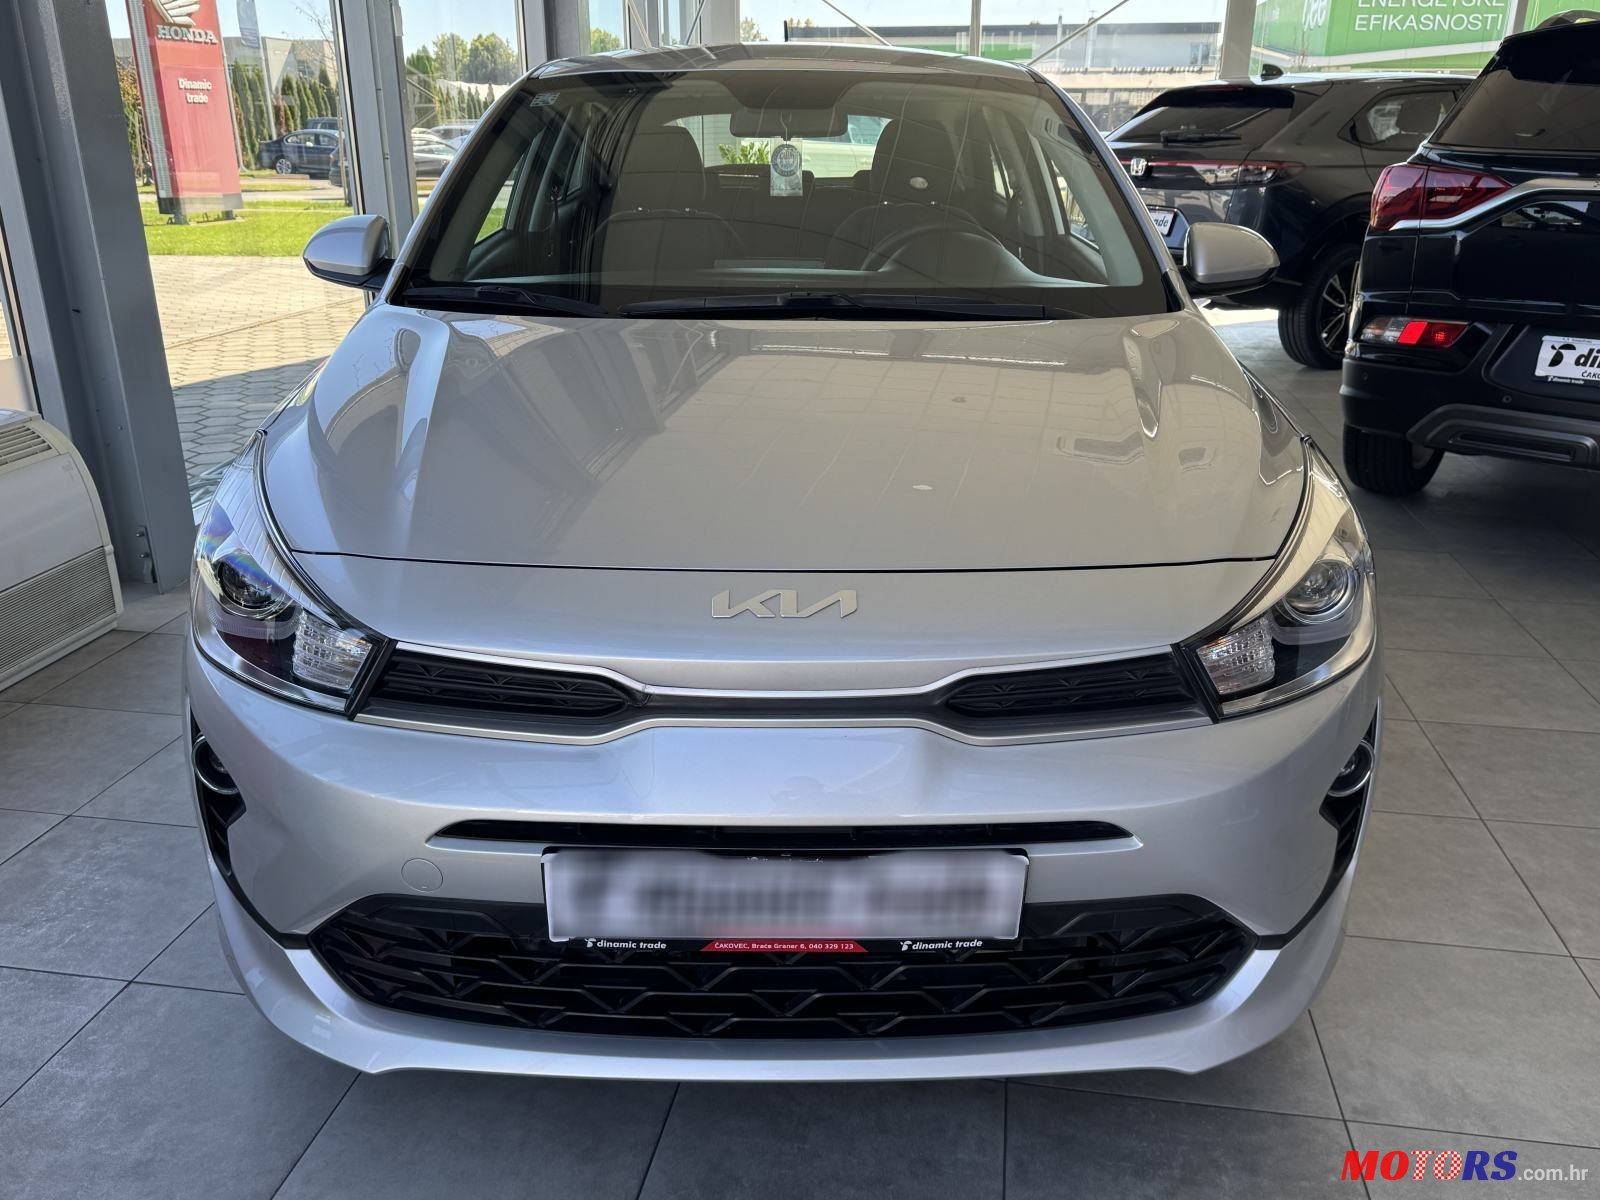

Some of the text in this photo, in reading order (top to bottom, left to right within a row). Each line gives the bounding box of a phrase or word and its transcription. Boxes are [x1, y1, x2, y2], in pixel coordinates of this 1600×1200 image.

[1354, 13, 1504, 31] EFIKASNOSTI
[156, 24, 219, 45] HONDA
[177, 77, 213, 91] Dinamic
[185, 92, 209, 104] trade
[711, 589, 858, 619] KIA
[596, 939, 667, 949] dinamic trade
[911, 938, 983, 950] dinamic trade
